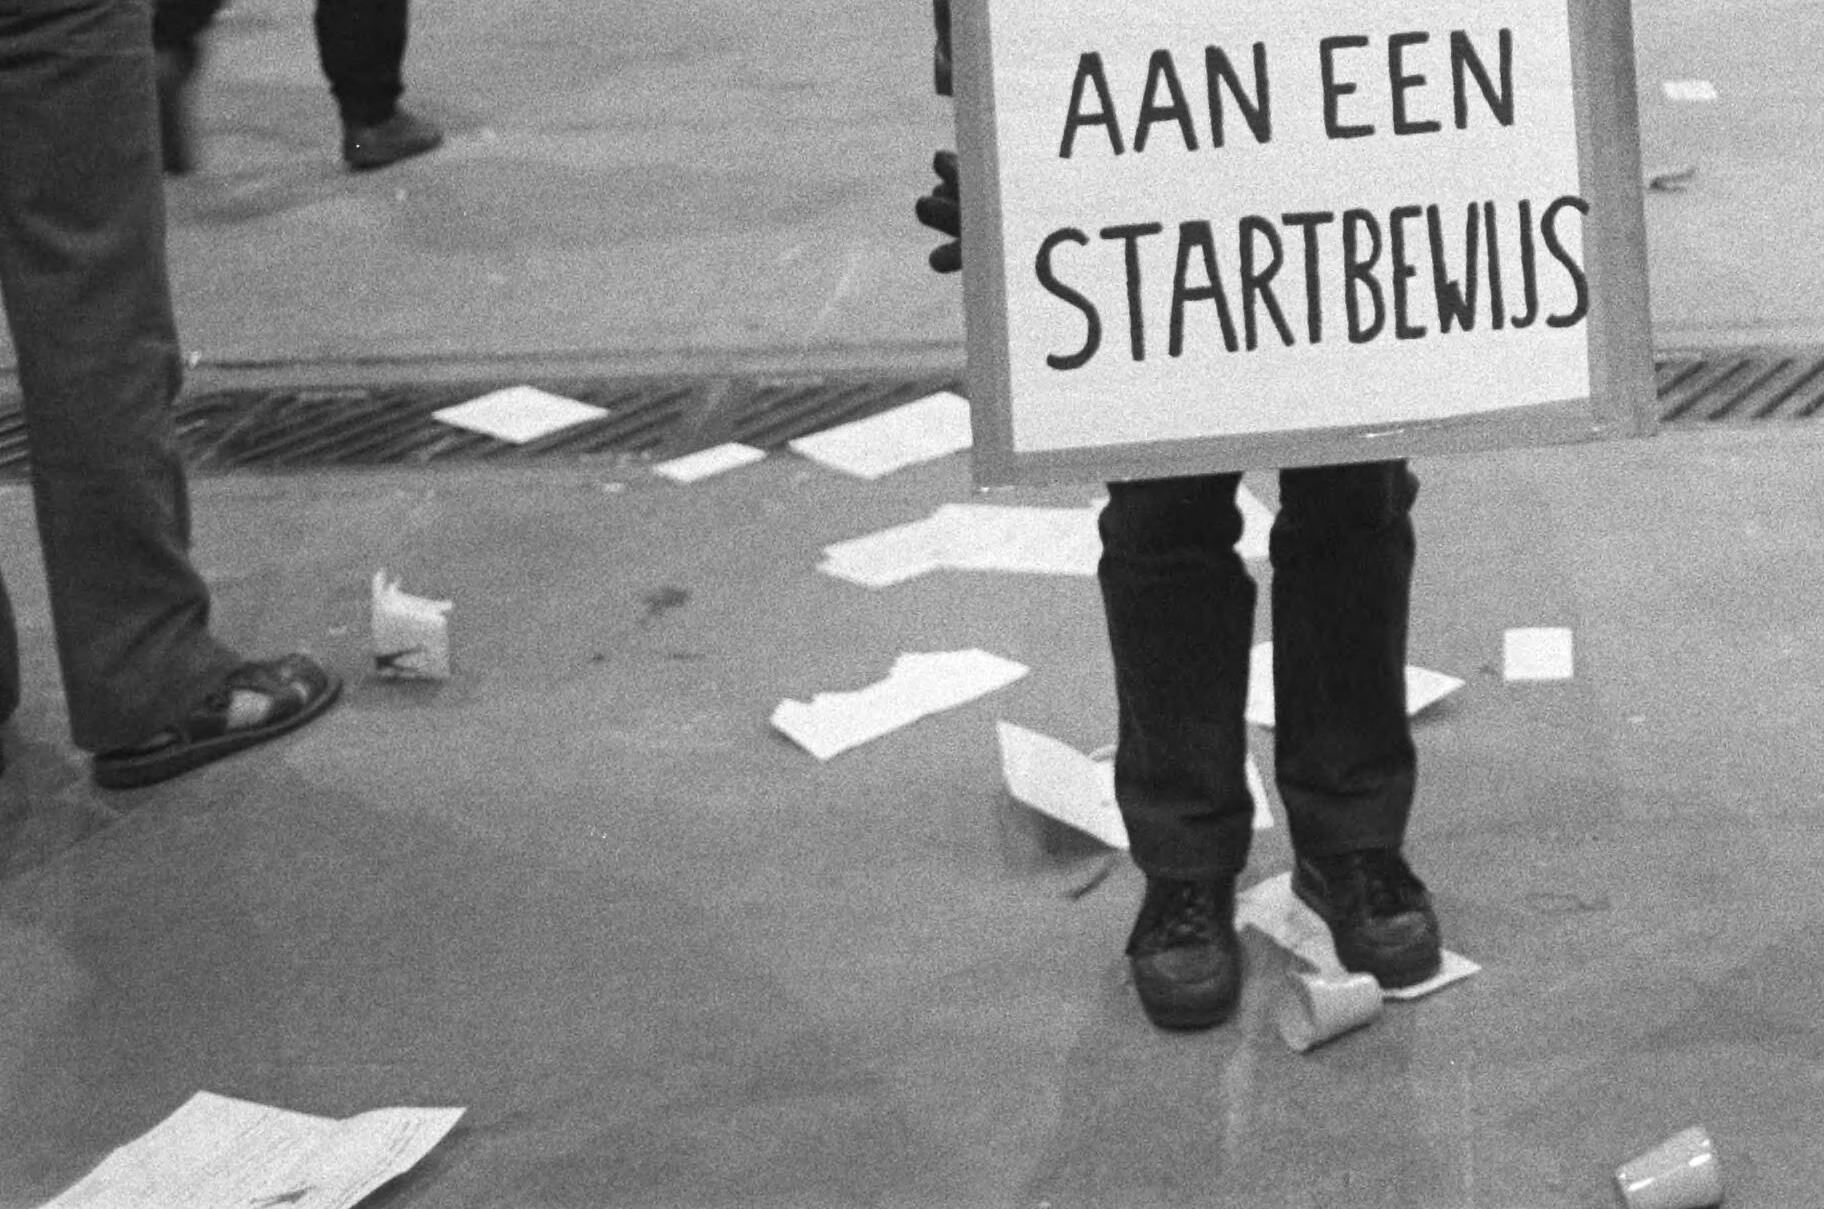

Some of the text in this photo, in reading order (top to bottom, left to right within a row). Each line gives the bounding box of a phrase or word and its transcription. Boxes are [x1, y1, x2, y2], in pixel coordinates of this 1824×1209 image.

[1058, 26, 1515, 160] AAN EEN
[1035, 194, 1591, 371] STARTBEWIJS
